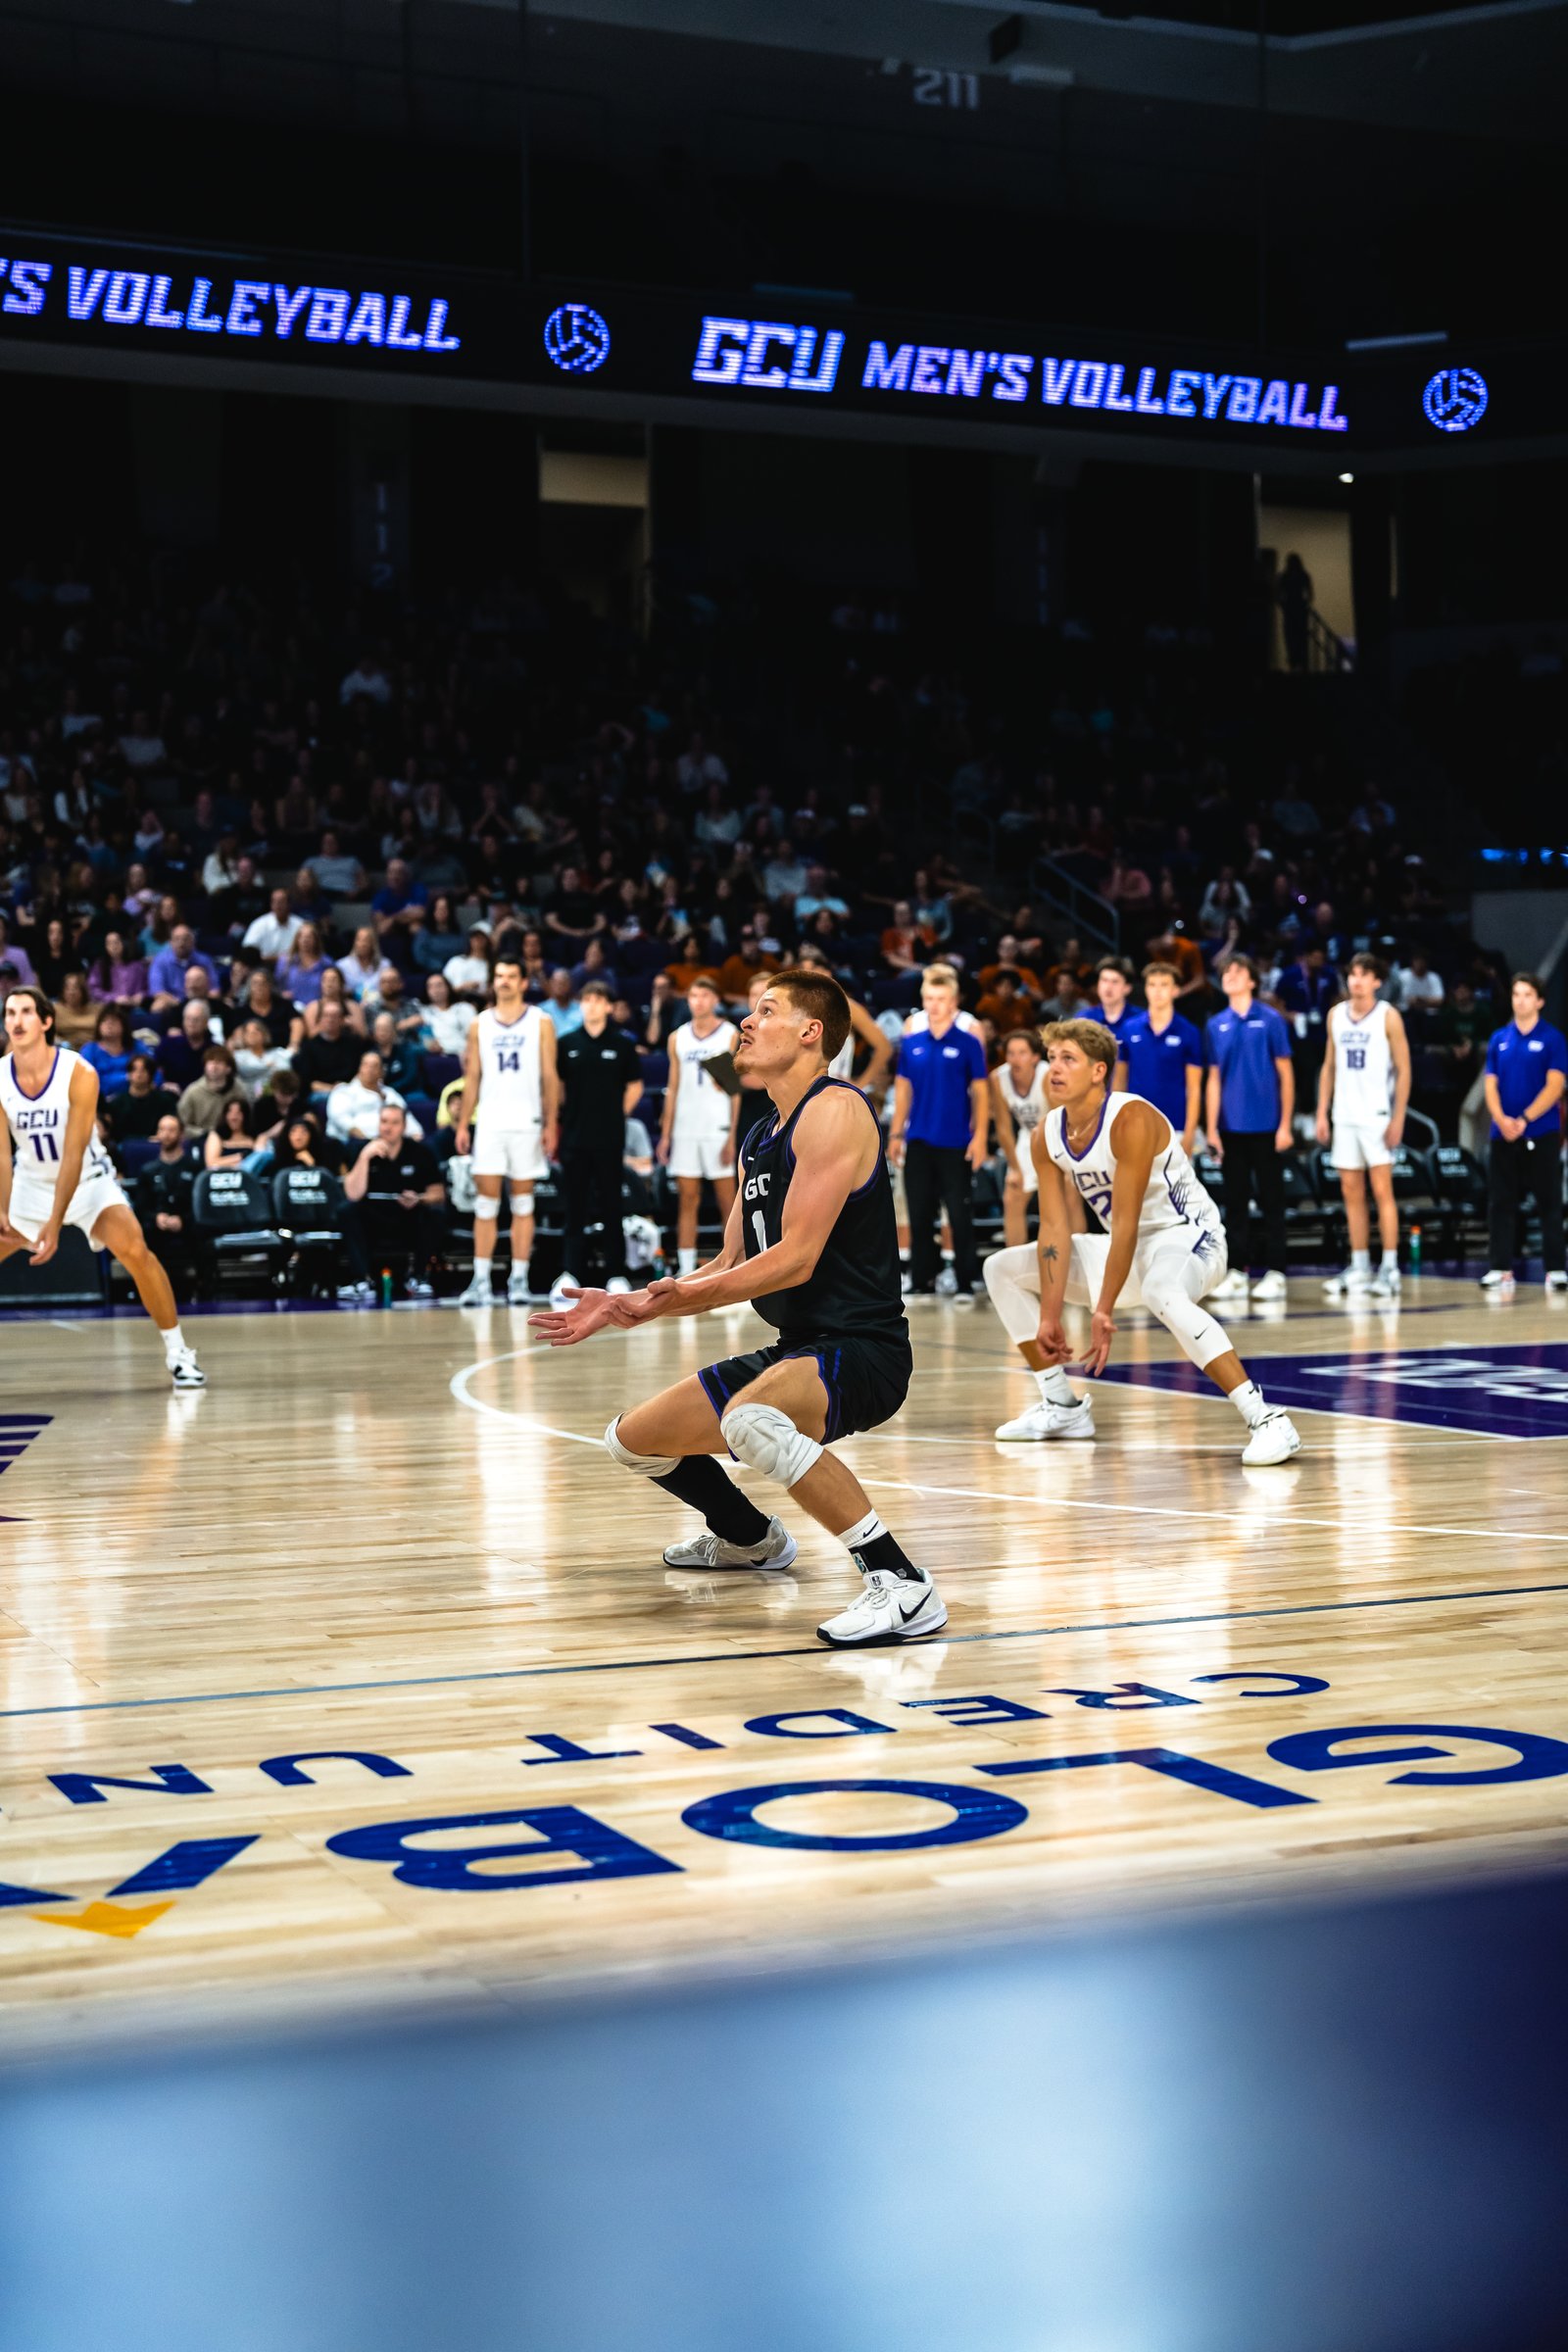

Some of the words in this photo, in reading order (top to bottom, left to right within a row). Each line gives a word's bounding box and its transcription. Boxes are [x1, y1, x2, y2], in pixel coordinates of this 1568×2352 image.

[911, 66, 979, 111] 211
[67, 266, 462, 354] VOLLEYBALL
[691, 315, 847, 393] GCU
[859, 340, 1036, 403] MEN'S
[1041, 356, 1349, 432] VOLLEYBALL
[498, 1051, 520, 1072] 14
[16, 1107, 59, 1130] GCU
[28, 1132, 60, 1163] 11
[1072, 1169, 1112, 1192] CU
[521, 1672, 1331, 1765] CREDIT
